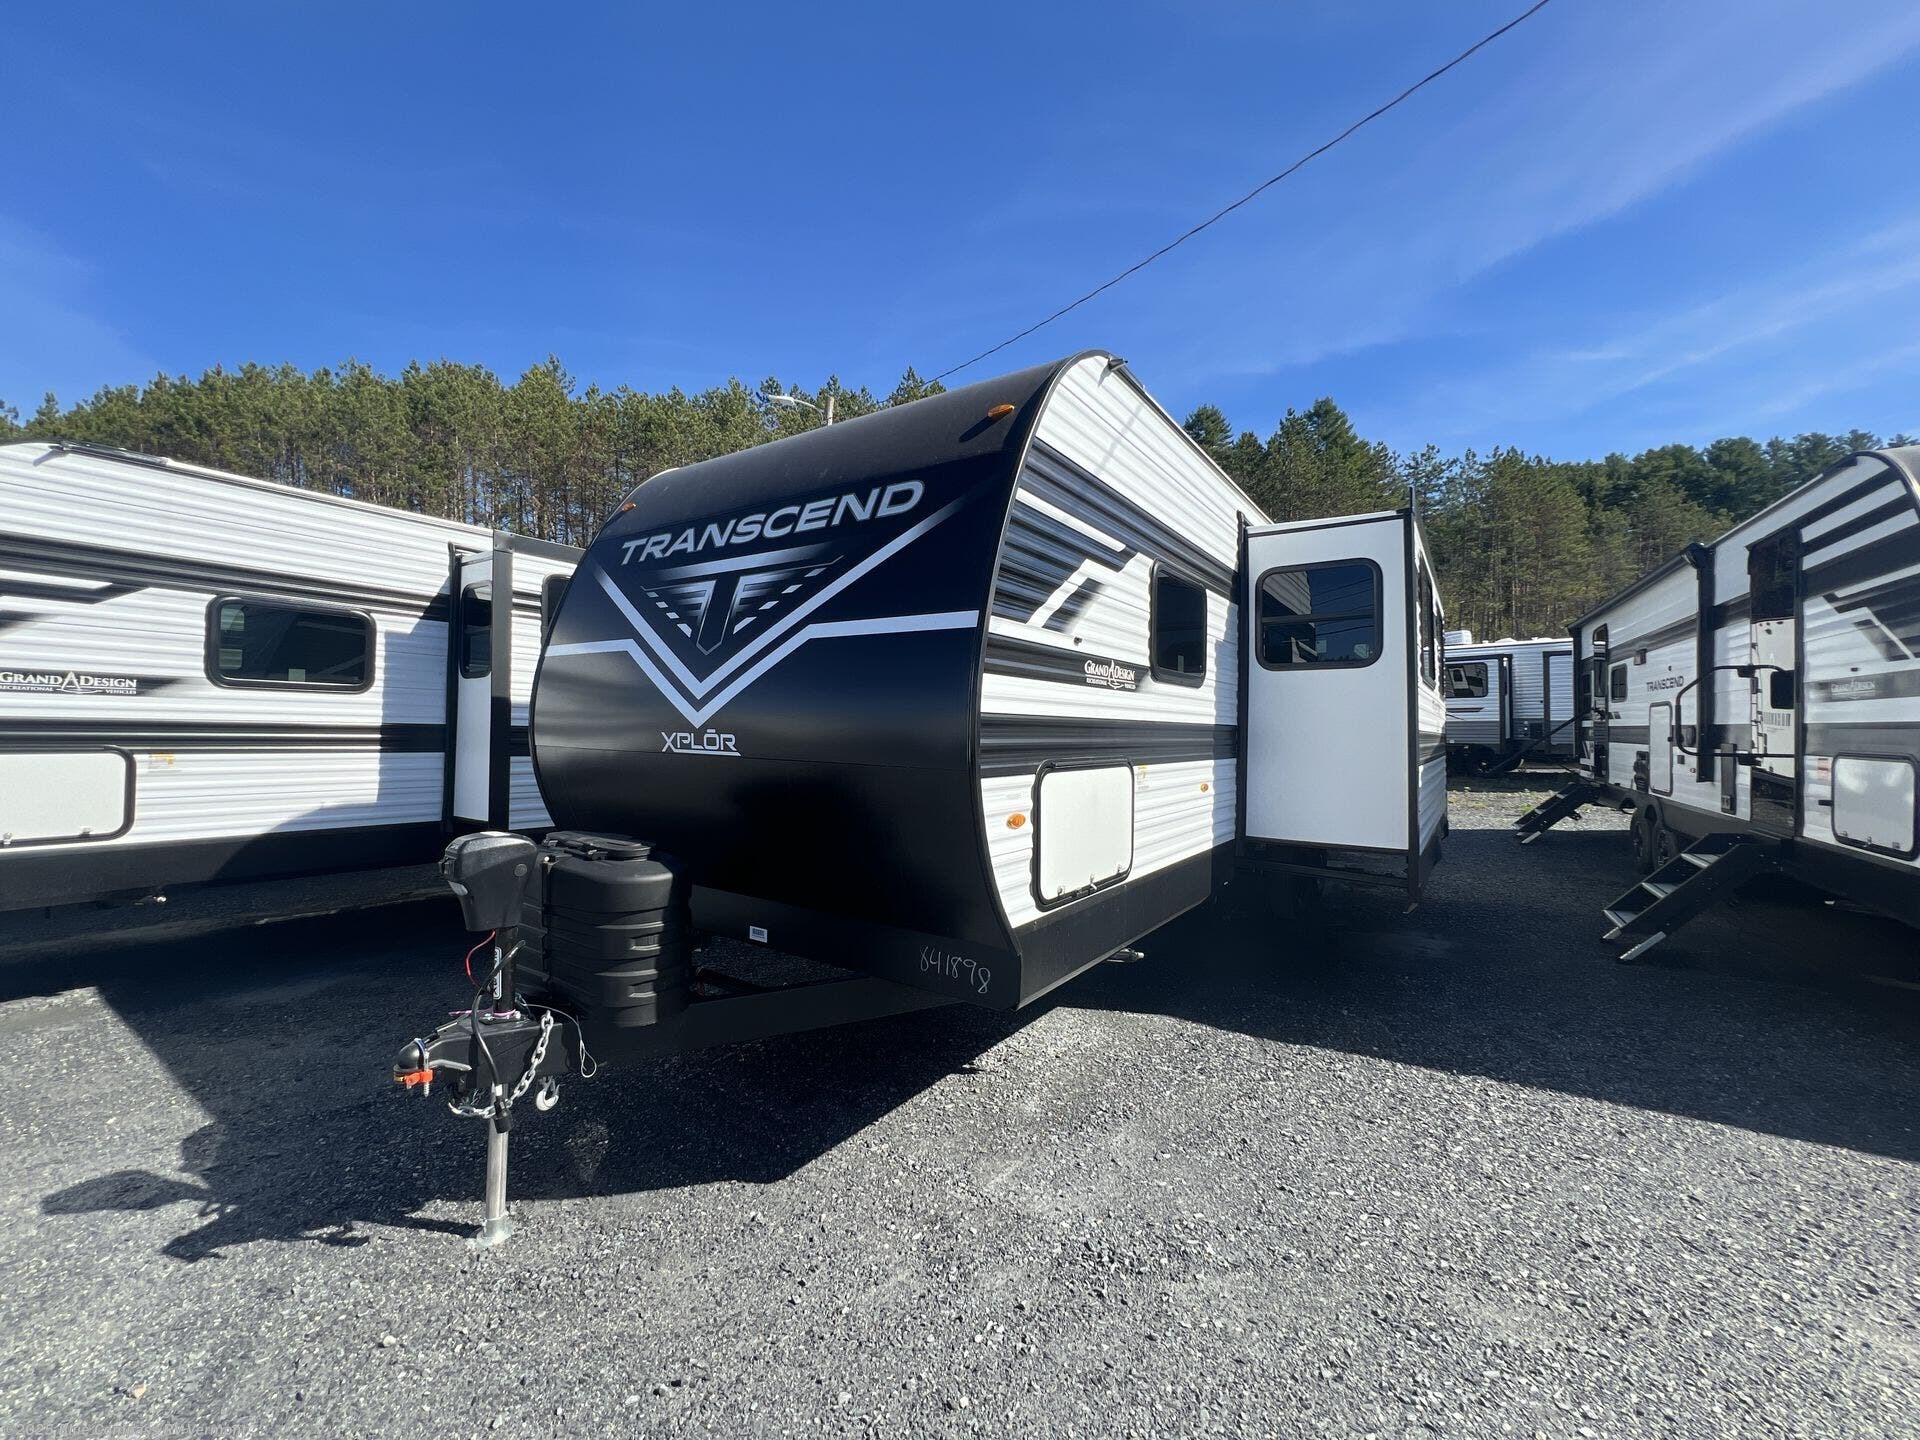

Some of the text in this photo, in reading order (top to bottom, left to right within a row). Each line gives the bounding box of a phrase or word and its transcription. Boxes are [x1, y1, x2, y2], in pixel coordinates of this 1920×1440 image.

[621, 480, 925, 566] TRANSCEND
[0, 672, 137, 688] GRAND DESIGN
[920, 946, 991, 994] 841898
